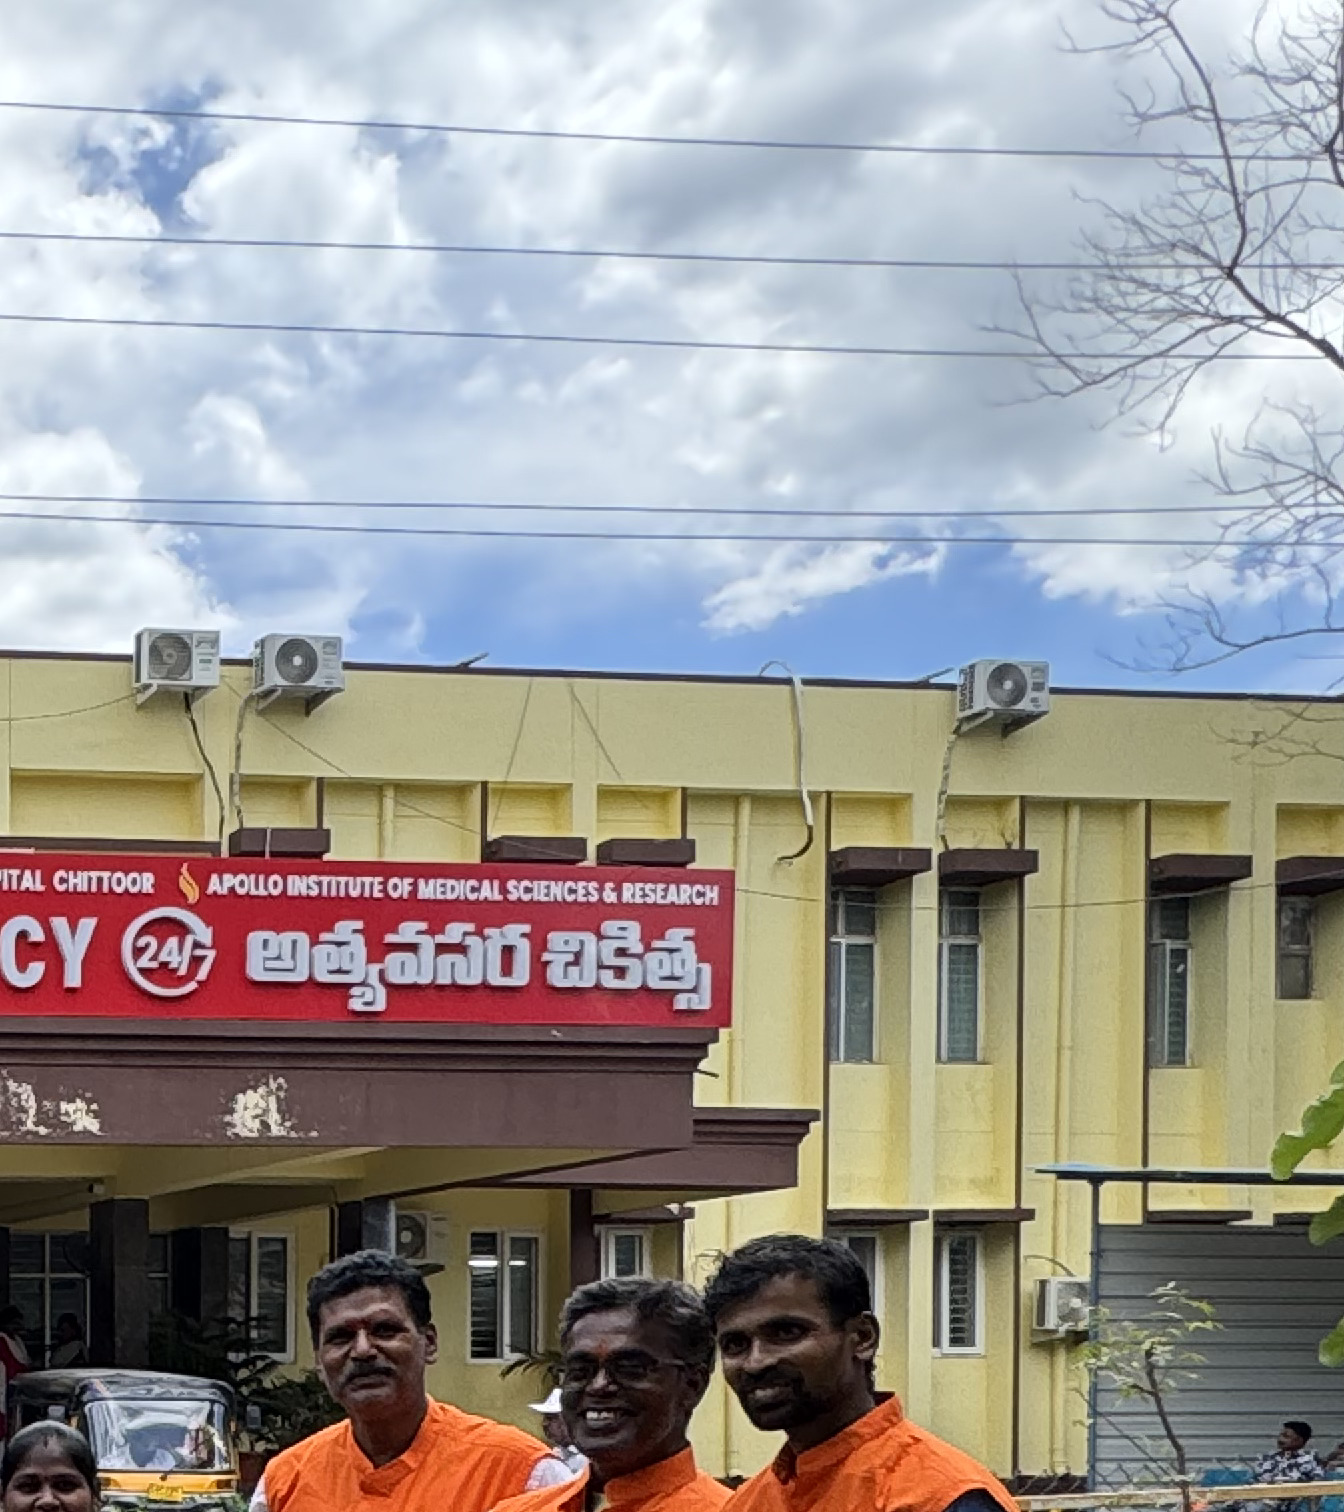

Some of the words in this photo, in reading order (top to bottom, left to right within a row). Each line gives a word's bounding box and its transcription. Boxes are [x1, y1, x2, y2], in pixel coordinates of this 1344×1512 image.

[52, 870, 155, 894] CHITTOOR
[206, 873, 284, 896] APOLLO
[287, 874, 384, 898] INSTITUTE
[387, 876, 414, 899] OF
[417, 877, 503, 901] MEDICAL
[506, 879, 600, 903] SCIENCES
[602, 882, 618, 904] &
[622, 882, 719, 906] RESEARCH
[135, 934, 217, 981] 24/7
[246, 919, 532, 1012] అత్యవసర
[541, 920, 712, 1010] చికిత్స
